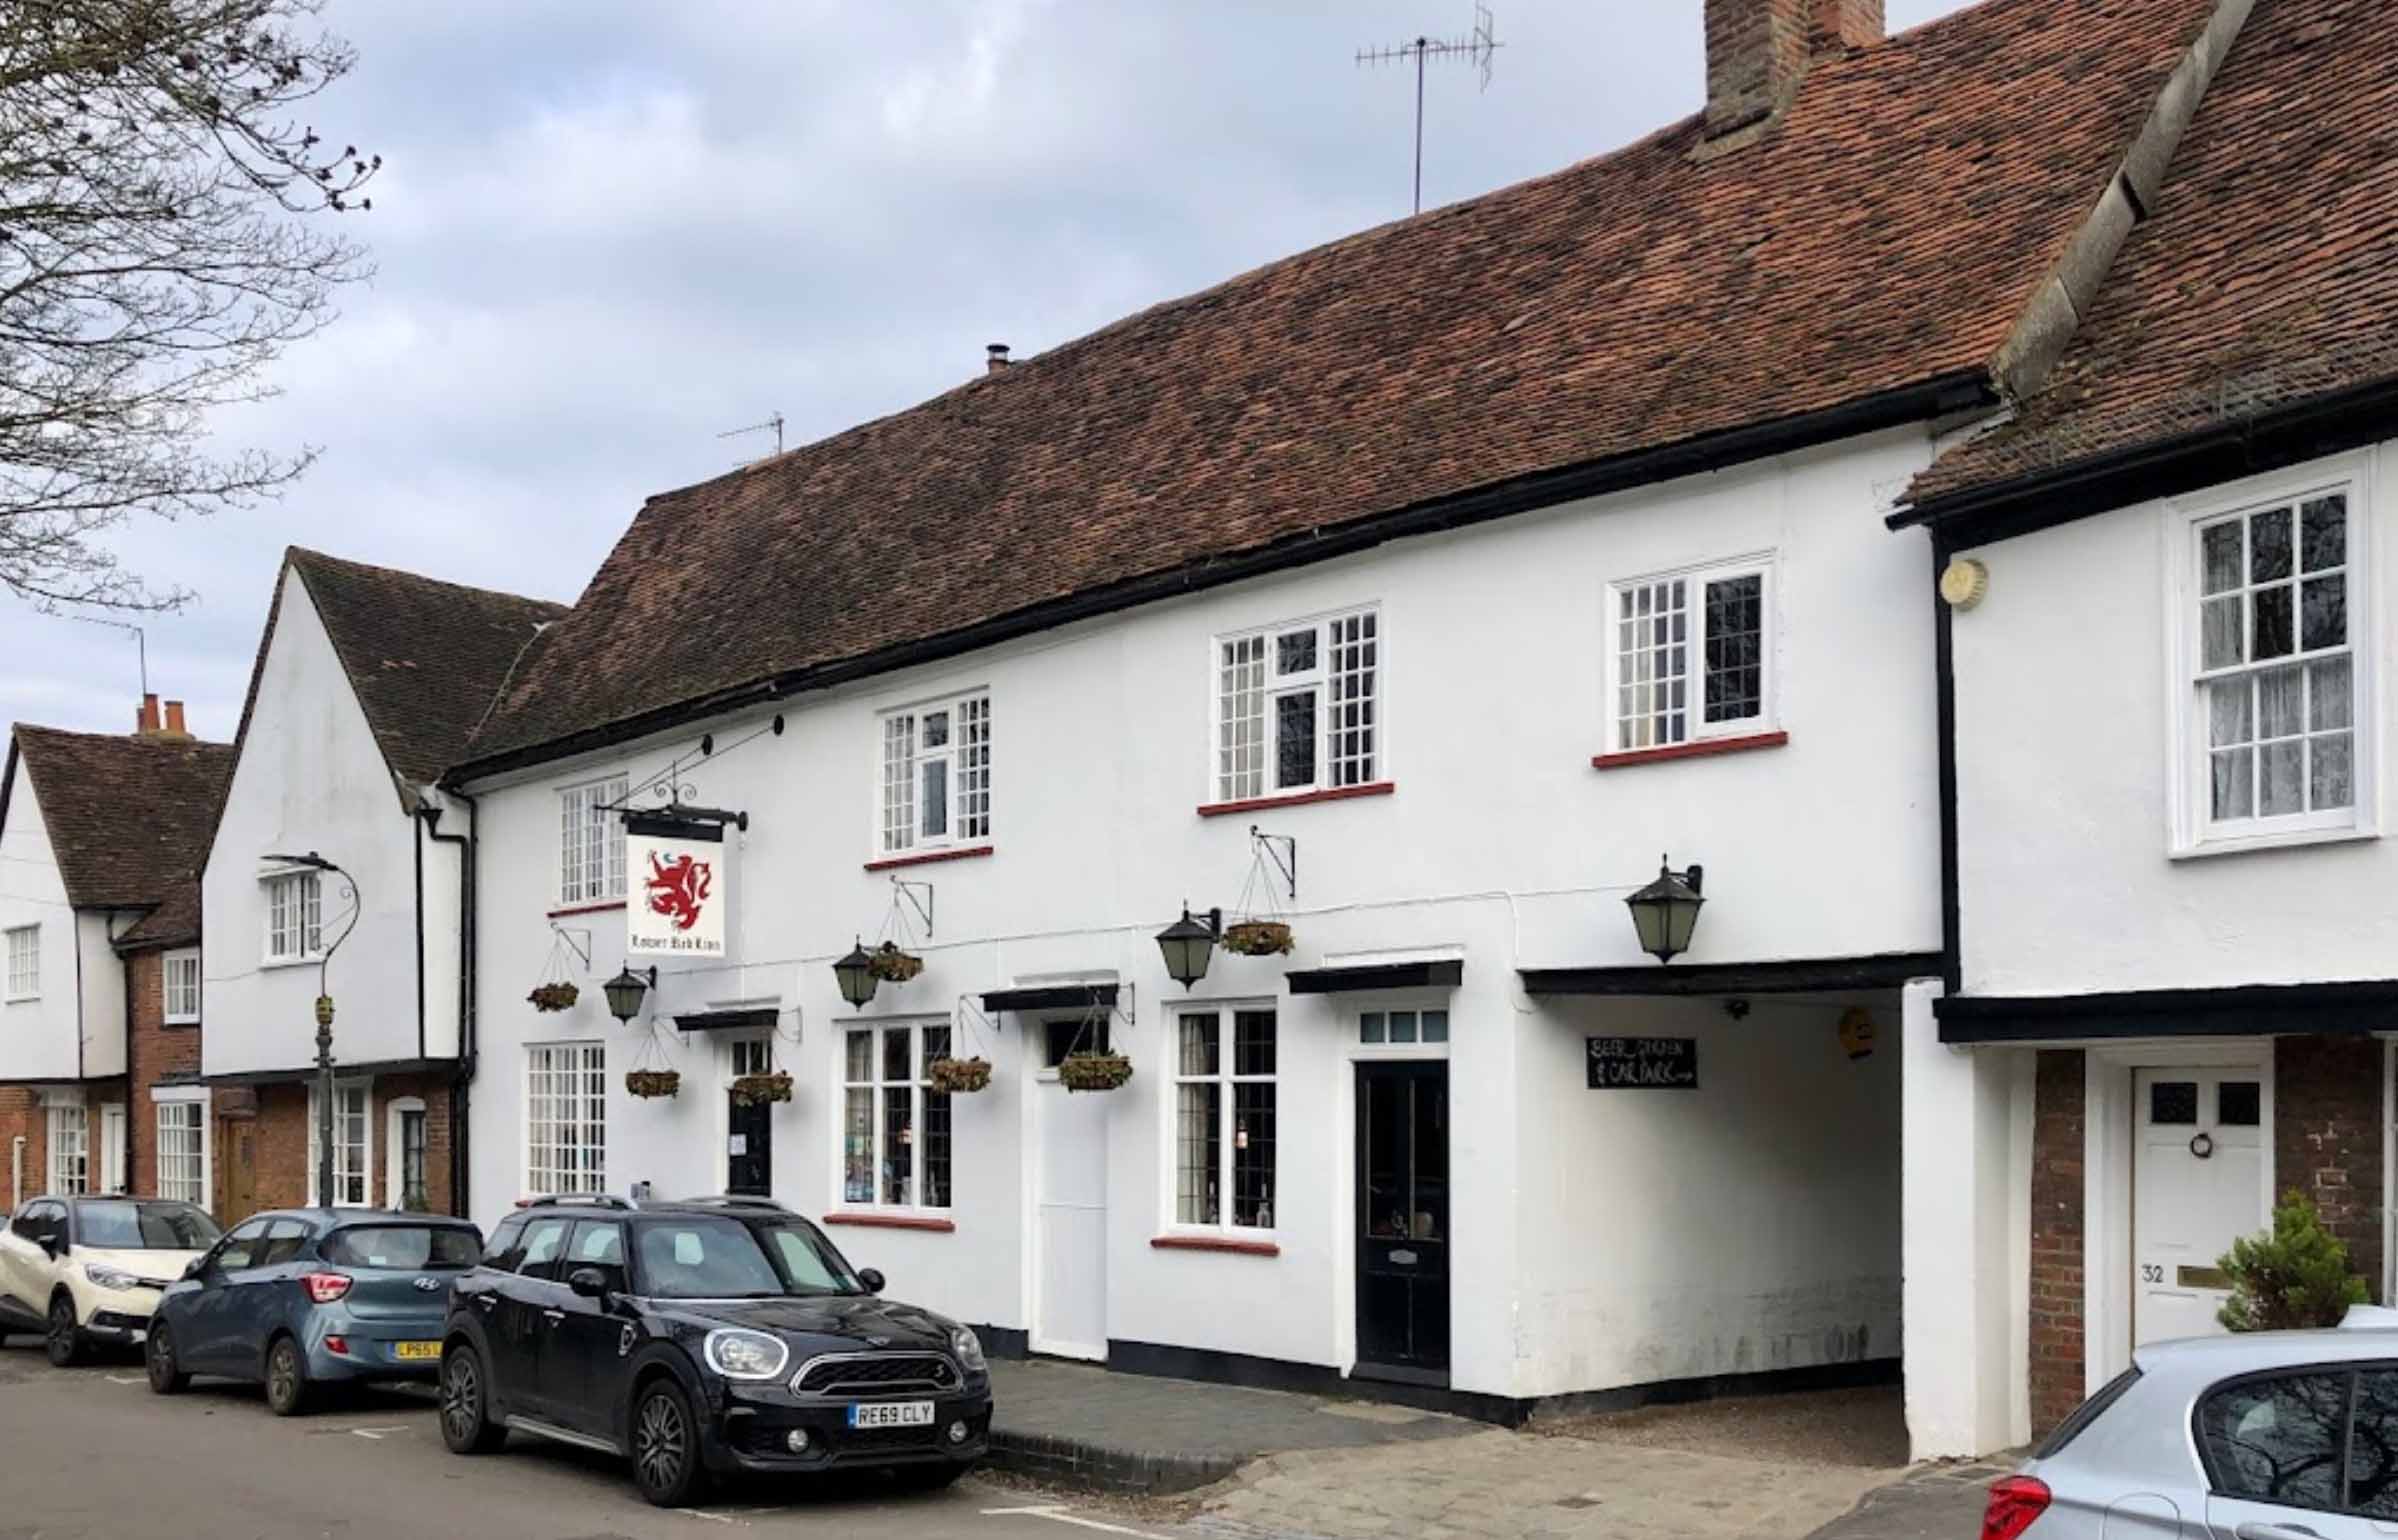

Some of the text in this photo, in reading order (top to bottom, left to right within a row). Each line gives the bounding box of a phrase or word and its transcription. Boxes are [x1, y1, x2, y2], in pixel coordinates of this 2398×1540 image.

[2141, 1264, 2164, 1284] 32
[858, 1404, 931, 1425] RE69 CLY
